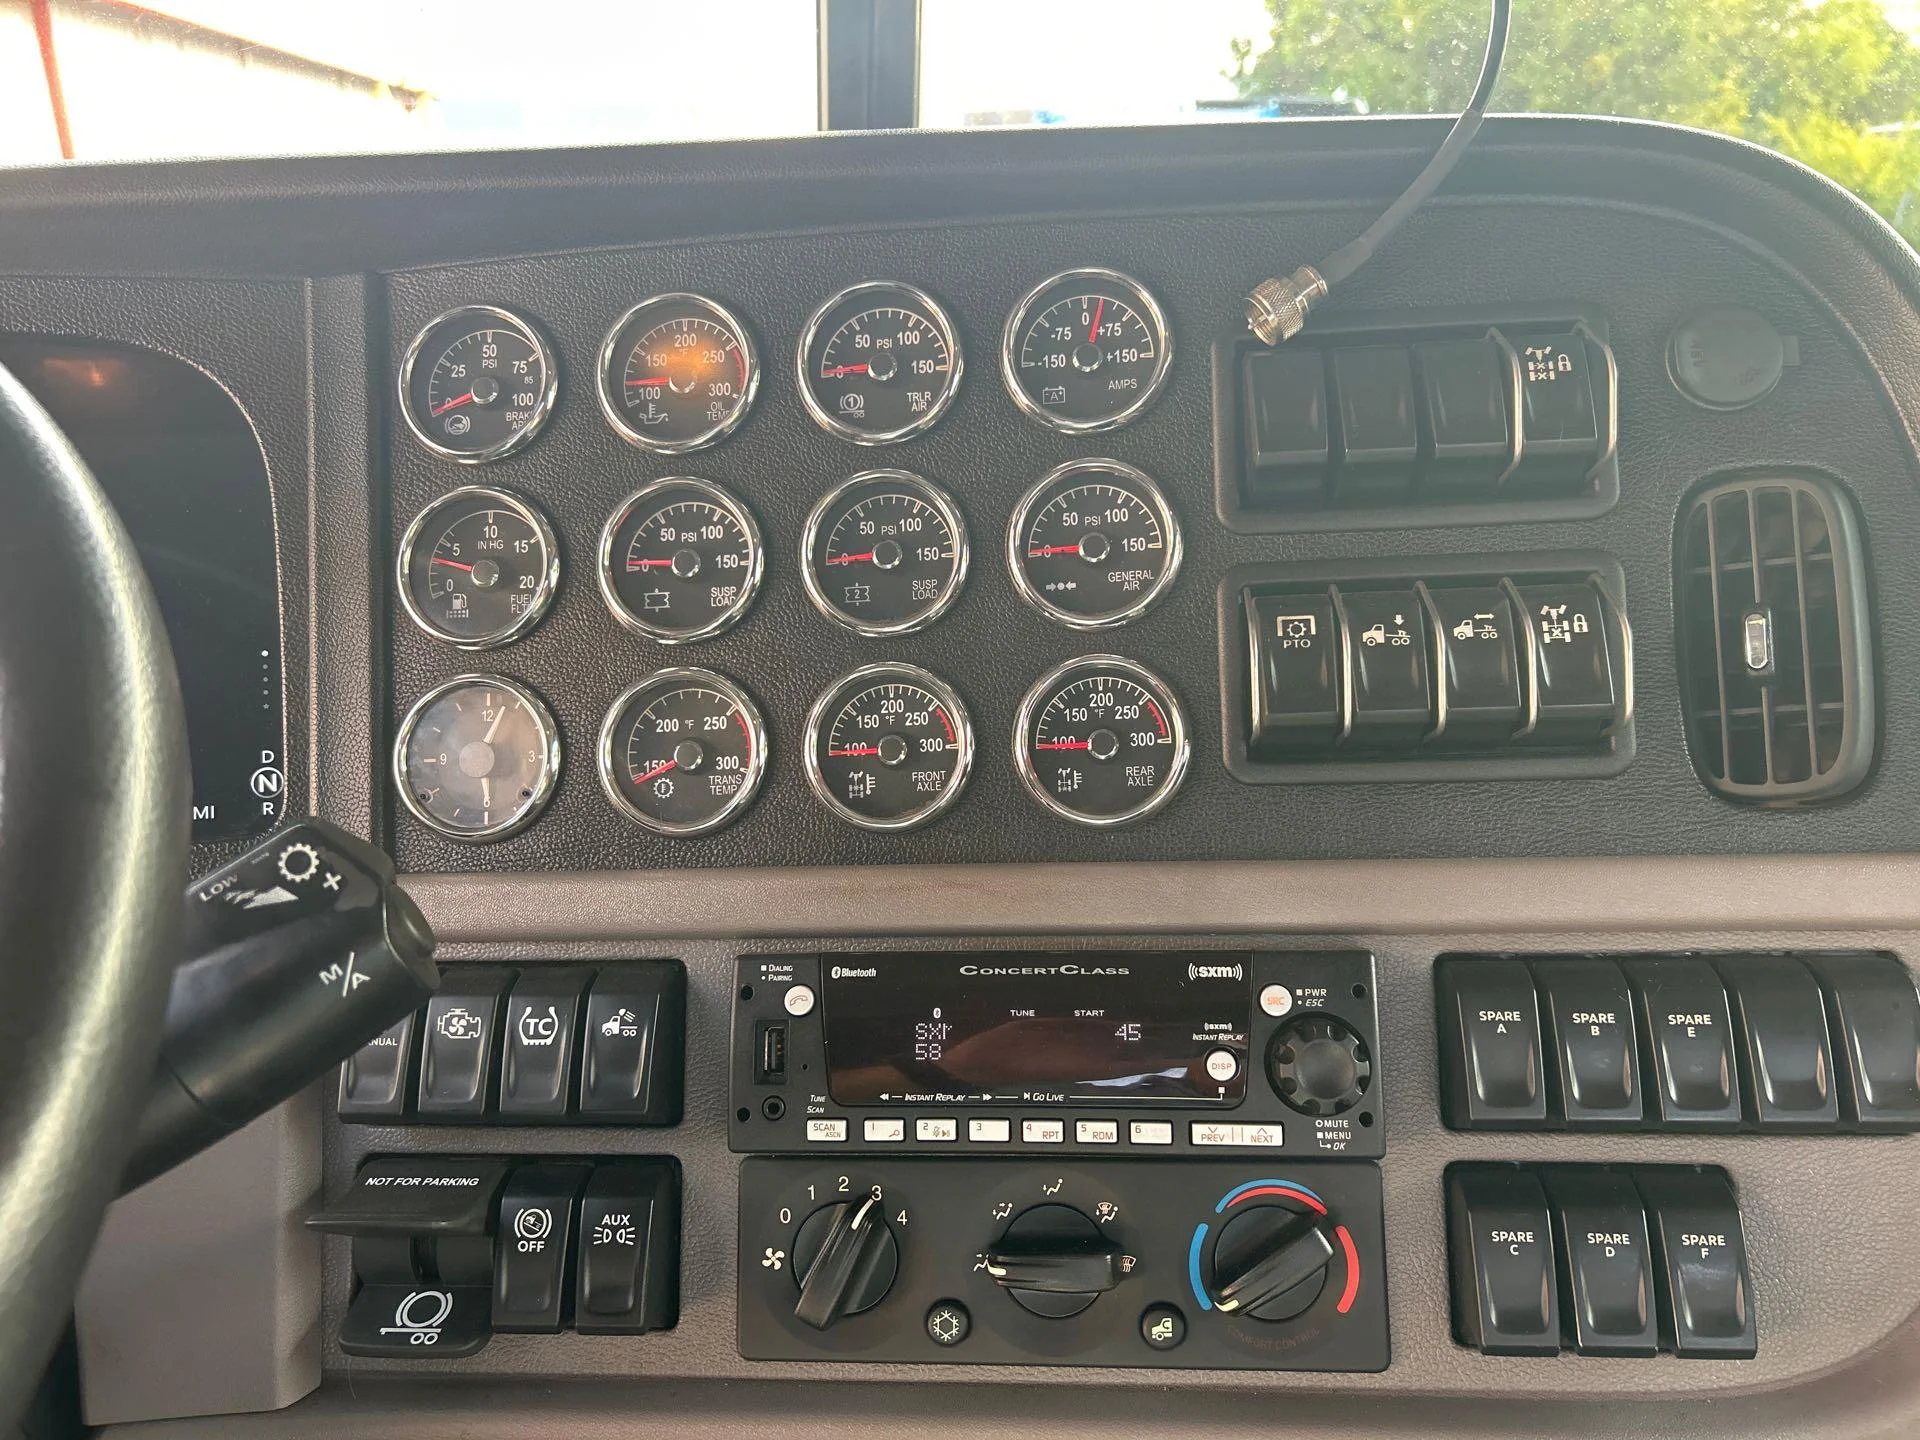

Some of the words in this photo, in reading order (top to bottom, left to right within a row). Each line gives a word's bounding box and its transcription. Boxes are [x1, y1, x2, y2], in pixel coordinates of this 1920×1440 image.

[1081, 312, 1090, 326] 0
[1051, 327, 1072, 341] -75
[1097, 323, 1122, 337] +75
[674, 334, 697, 348] 200
[855, 334, 871, 348] 50
[876, 338, 893, 349] PSI
[897, 331, 920, 345] 100
[482, 344, 497, 358] 50
[702, 350, 725, 363] 250
[1107, 349, 1138, 363] +150
[482, 359, 497, 369] PSI
[645, 354, 667, 367] 150
[1038, 354, 1066, 369] -150
[451, 365, 467, 378] 25
[512, 361, 527, 374] 75
[911, 360, 934, 374] 150
[524, 376, 534, 384] 85
[1108, 379, 1138, 390] AMPS
[638, 387, 661, 400] 100
[709, 383, 731, 396] 300
[512, 393, 534, 406] 100
[907, 392, 932, 402] TRLR
[710, 402, 725, 411] OIL
[911, 402, 928, 412] AIR
[506, 411, 533, 421] BRAK
[1062, 512, 1078, 526] 50
[1084, 516, 1101, 526] PSI
[1104, 508, 1129, 523] 100
[483, 526, 498, 539] 10
[859, 521, 875, 535] 50
[881, 525, 897, 535] PSI
[899, 518, 922, 532] 100
[660, 528, 676, 542] 50
[681, 532, 697, 543] PSI
[700, 526, 724, 539] 100
[452, 543, 460, 556] 5
[477, 540, 487, 550] IN
[490, 540, 504, 550] HG
[513, 540, 529, 553] 15
[1121, 537, 1146, 552] 150
[916, 547, 939, 561] 150
[715, 555, 738, 569] 150
[519, 575, 534, 589] 20
[1107, 569, 1155, 583] GENERAL
[446, 579, 454, 591] 0
[912, 580, 938, 590] SUSP
[1122, 580, 1140, 592] AIR
[711, 586, 737, 597] SUSP
[912, 589, 938, 600] LOAD
[1283, 639, 1311, 649] PTO
[1089, 693, 1114, 707] 200
[880, 700, 904, 714] 200
[481, 710, 494, 722] 12
[1063, 708, 1088, 722] 150
[1114, 705, 1139, 720] 250
[656, 719, 679, 733] 200
[703, 716, 727, 730] 250
[856, 715, 879, 729] 150
[905, 712, 929, 726] 250
[919, 738, 943, 753] 300
[1130, 732, 1155, 747] 300
[262, 750, 274, 764] D
[440, 753, 447, 765] 9
[528, 750, 536, 763] 3
[715, 756, 739, 770] 300
[912, 771, 947, 782] FRONT
[1126, 766, 1155, 776] REAR
[258, 773, 278, 793] N
[709, 775, 742, 786] TRANS
[917, 781, 942, 791] AXLE
[1127, 776, 1153, 787] AXLE
[710, 785, 738, 796] TEMP
[193, 806, 215, 820] MI
[262, 802, 274, 815] R
[200, 873, 238, 902] LOW
[841, 967, 877, 978] Bluetooth
[1305, 988, 1327, 997] PWR
[1305, 999, 1324, 1007] ESC
[1010, 1009, 1035, 1017] TUNE
[1074, 1009, 1105, 1017] START
[1479, 1010, 1521, 1022] SPARE
[1572, 1012, 1616, 1024] SPARE
[1668, 1014, 1711, 1025] SPARE
[525, 1018, 552, 1035] TC
[1115, 1023, 1142, 1041] 45
[1497, 1024, 1507, 1034] A
[1591, 1025, 1600, 1036] B
[1687, 1027, 1695, 1037] E
[915, 1043, 941, 1060] 58
[813, 1123, 836, 1131] SCAN
[923, 1123, 929, 1131] 2
[976, 1123, 982, 1131] 3
[1026, 1124, 1032, 1132] 4
[1081, 1124, 1087, 1132] 5
[1135, 1125, 1142, 1134] 6
[1324, 1120, 1349, 1128] MUTE
[1042, 1131, 1060, 1140] RPT
[1092, 1132, 1114, 1140] RDM
[1201, 1134, 1225, 1143] PREV
[1250, 1135, 1274, 1143] NEXT
[1324, 1131, 1351, 1140] MENU
[1333, 1142, 1346, 1150] OK
[365, 1177, 392, 1186] NOT
[393, 1177, 421, 1186] FOR
[422, 1177, 480, 1186] PARKING
[838, 1176, 849, 1192] 2
[807, 1185, 815, 1200] 1
[871, 1185, 882, 1201] 3
[602, 1214, 630, 1226] AUX
[780, 1208, 791, 1224] 0
[897, 1210, 908, 1225] 4
[1491, 1231, 1534, 1242] SPARE
[1587, 1233, 1630, 1245] SPARE
[1681, 1235, 1725, 1246] SPARE
[518, 1241, 545, 1252] OFF
[1510, 1245, 1519, 1255] C
[1605, 1247, 1615, 1257] D
[1701, 1248, 1709, 1259] F
